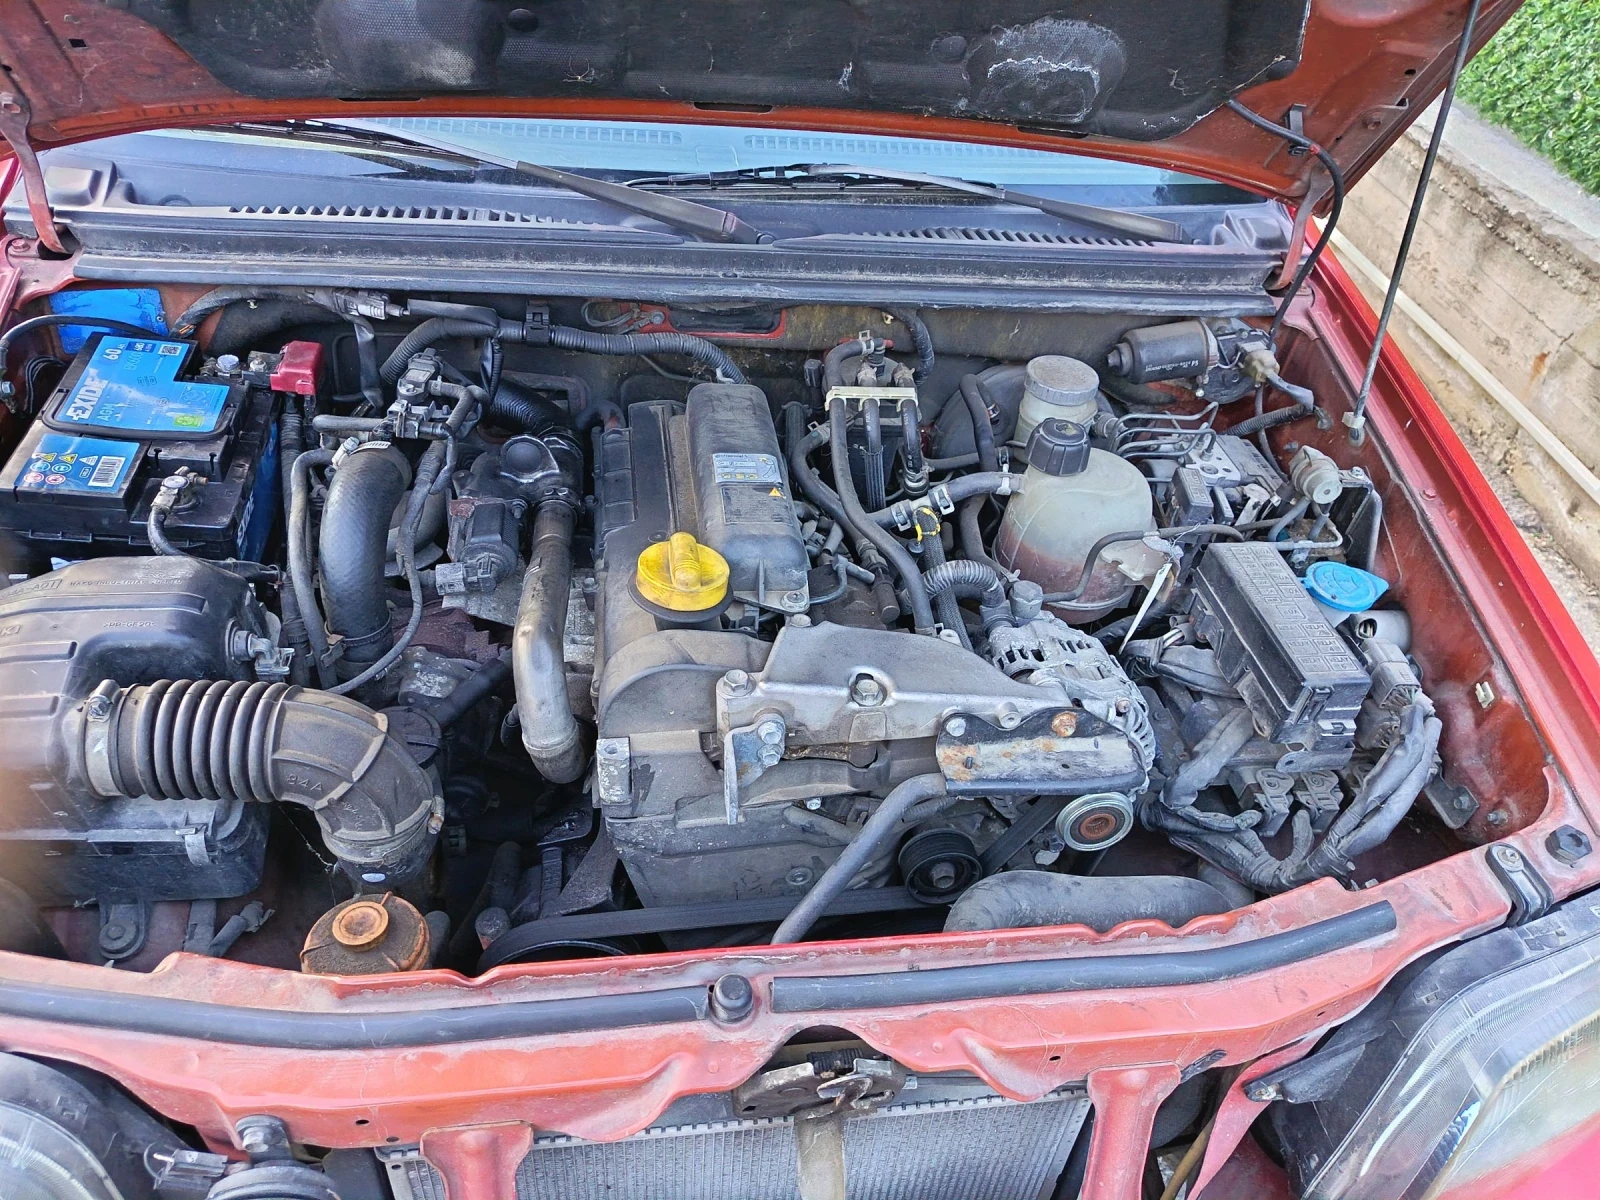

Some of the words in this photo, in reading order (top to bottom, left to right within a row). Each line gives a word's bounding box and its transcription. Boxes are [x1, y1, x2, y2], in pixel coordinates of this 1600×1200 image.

[103, 348, 122, 361] 60
[66, 375, 110, 421] EXIDE
[97, 403, 116, 422] AGM
